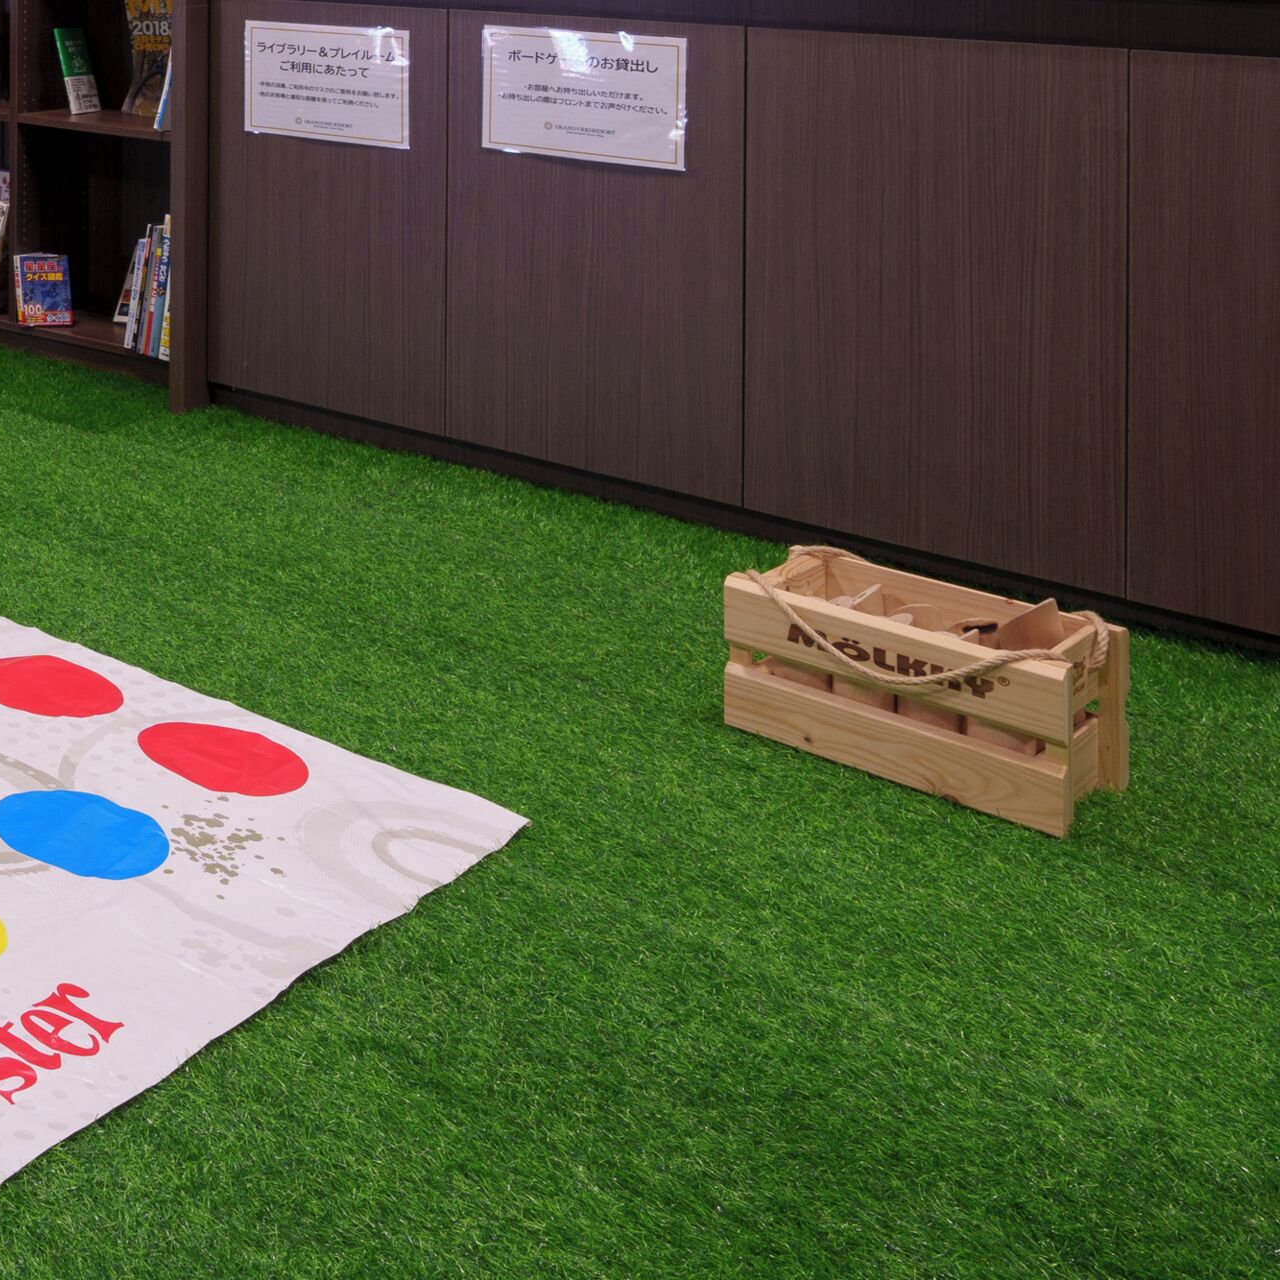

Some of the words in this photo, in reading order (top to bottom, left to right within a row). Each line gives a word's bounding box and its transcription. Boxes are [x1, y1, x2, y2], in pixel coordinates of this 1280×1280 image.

[132, 20, 170, 36] 2018
[279, 60, 370, 78] ご利用にあたって
[508, 49, 659, 74] ボードゲのお貸出し
